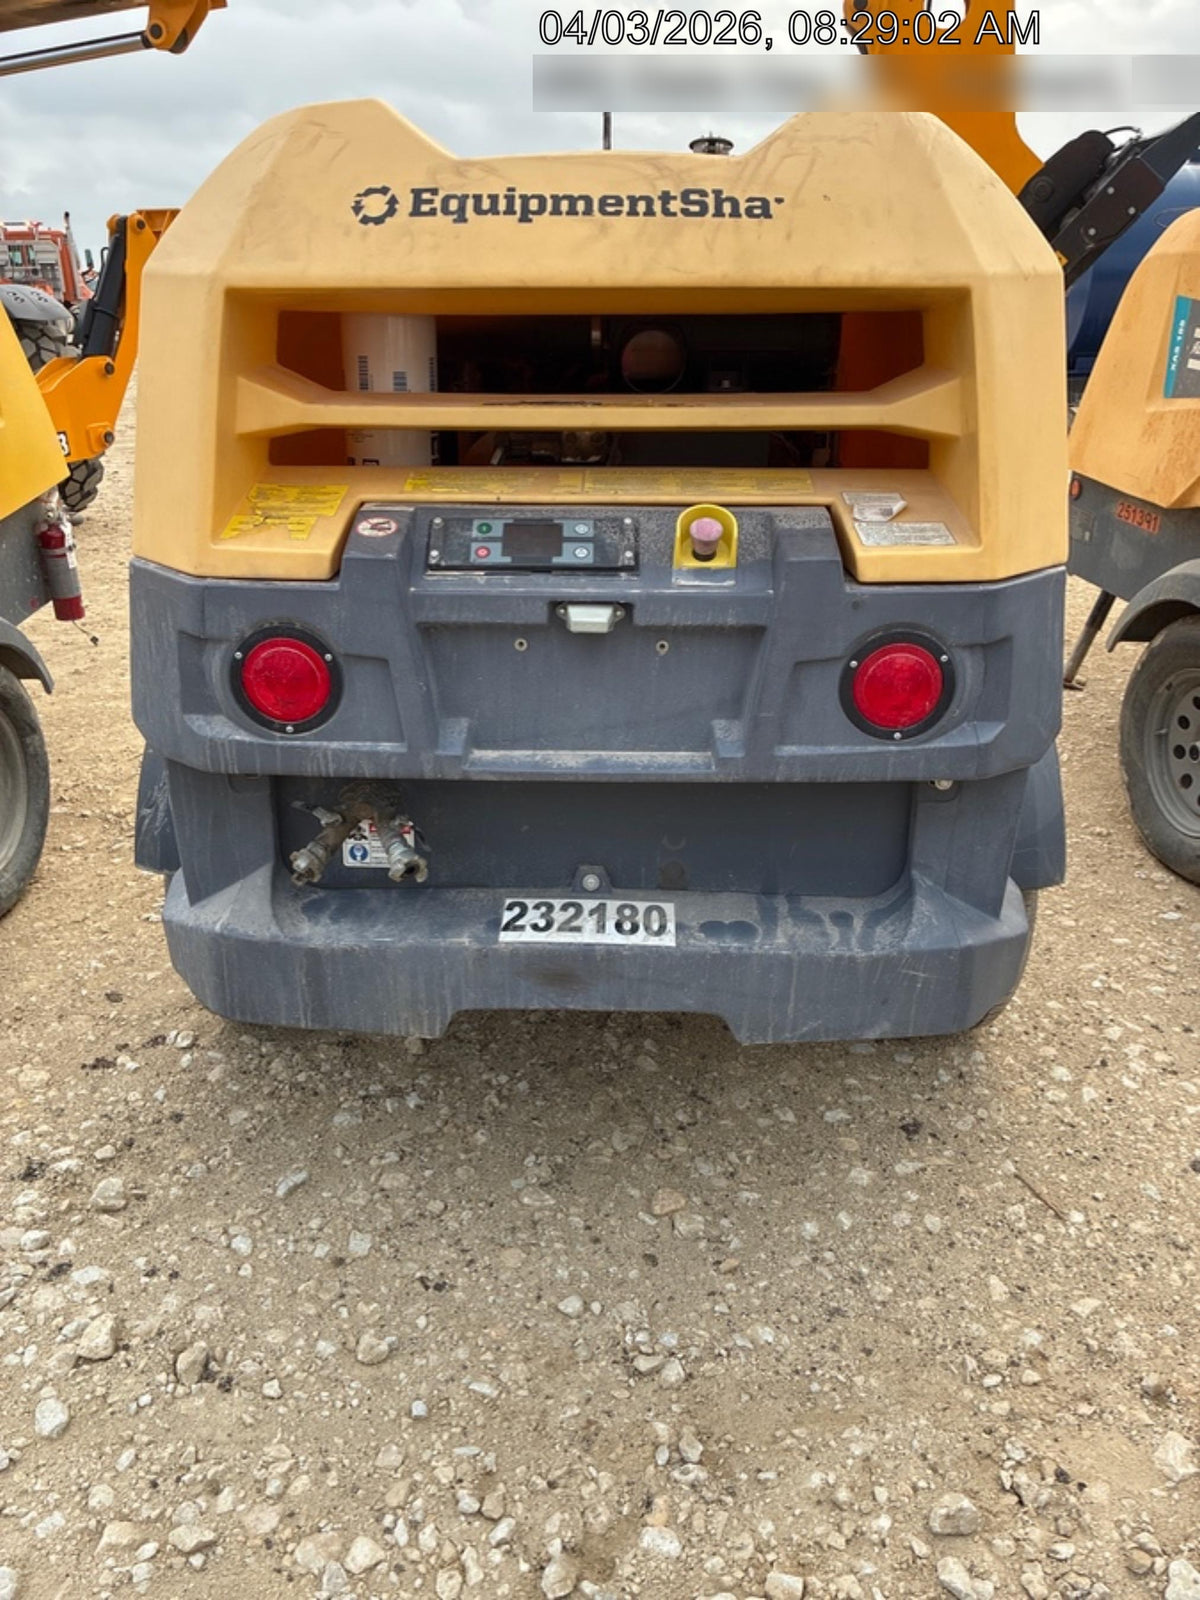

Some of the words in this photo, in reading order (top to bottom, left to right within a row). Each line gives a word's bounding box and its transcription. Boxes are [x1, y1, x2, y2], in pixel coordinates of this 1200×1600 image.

[408, 186, 785, 224] EquipmentSha
[1117, 501, 1159, 532] 251391
[500, 900, 668, 937] 232180
